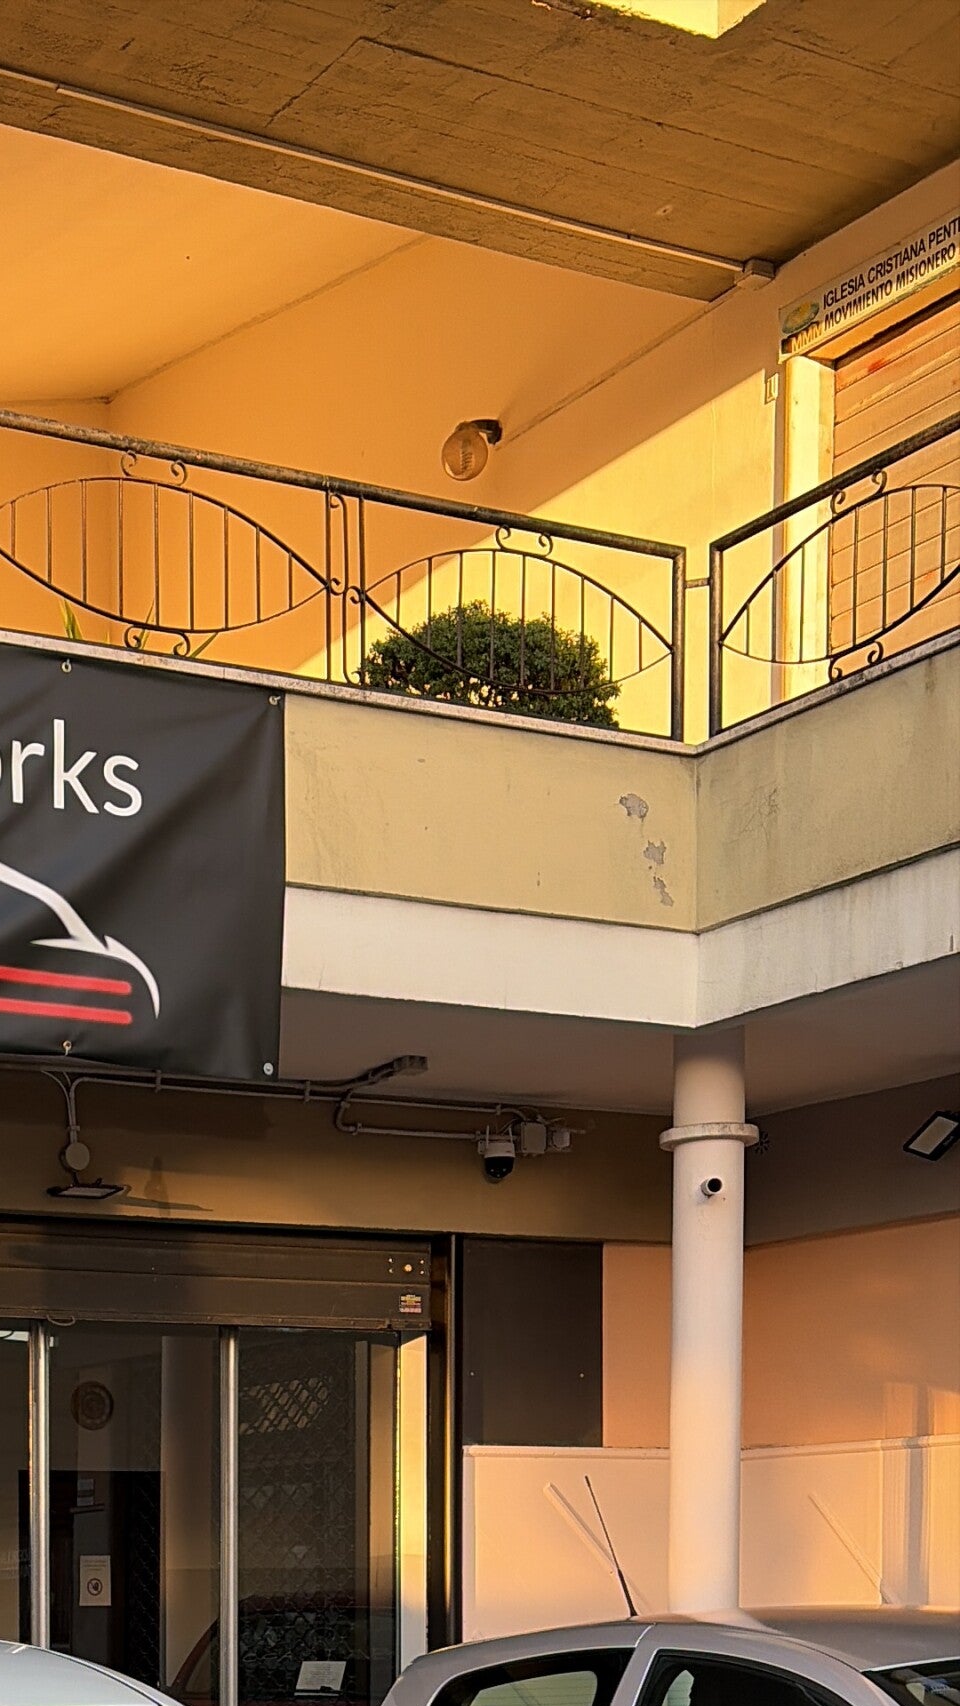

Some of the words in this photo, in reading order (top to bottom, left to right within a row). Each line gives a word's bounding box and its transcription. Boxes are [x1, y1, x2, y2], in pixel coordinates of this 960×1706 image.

[823, 274, 866, 310] IGLESIA
[867, 238, 927, 284] CRISTIANA
[824, 279, 893, 332] MOVIMIENTO
[895, 242, 956, 292] MISIONERO
